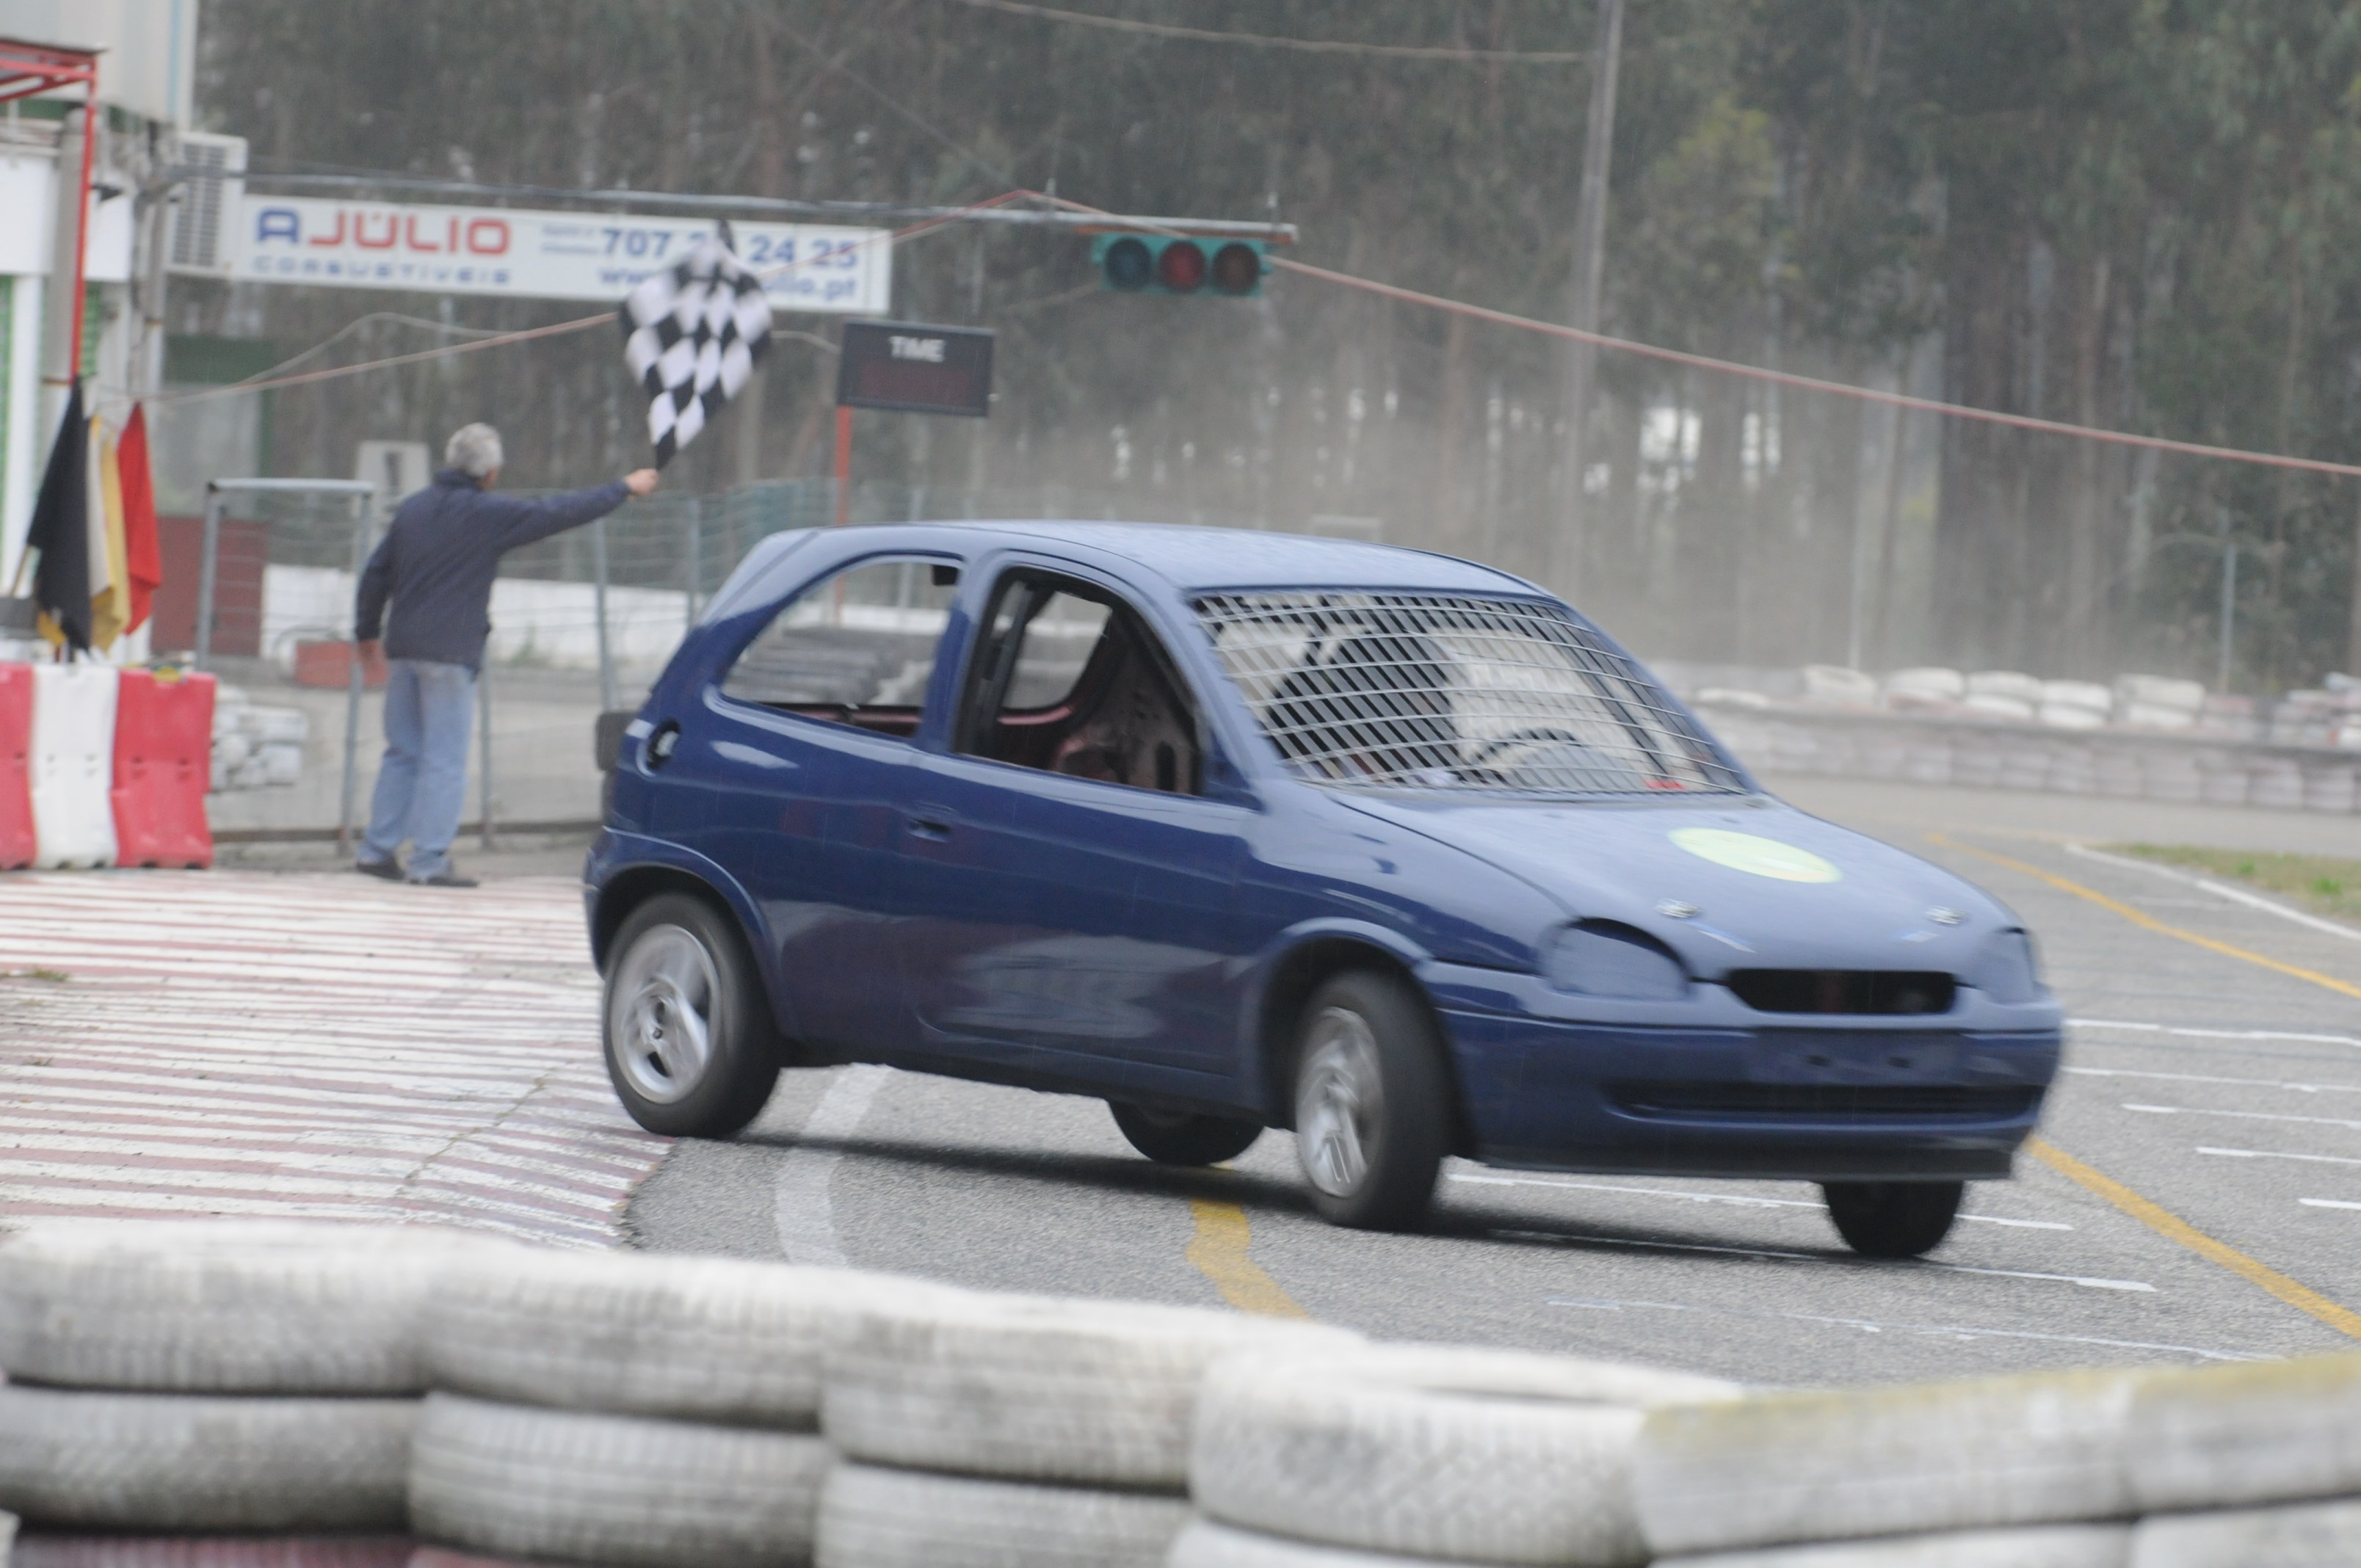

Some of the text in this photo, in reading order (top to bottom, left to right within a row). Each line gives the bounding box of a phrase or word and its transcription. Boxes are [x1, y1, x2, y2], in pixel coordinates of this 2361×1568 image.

[602, 228, 671, 257] 707
[750, 234, 795, 264] 24
[811, 239, 857, 268] 25
